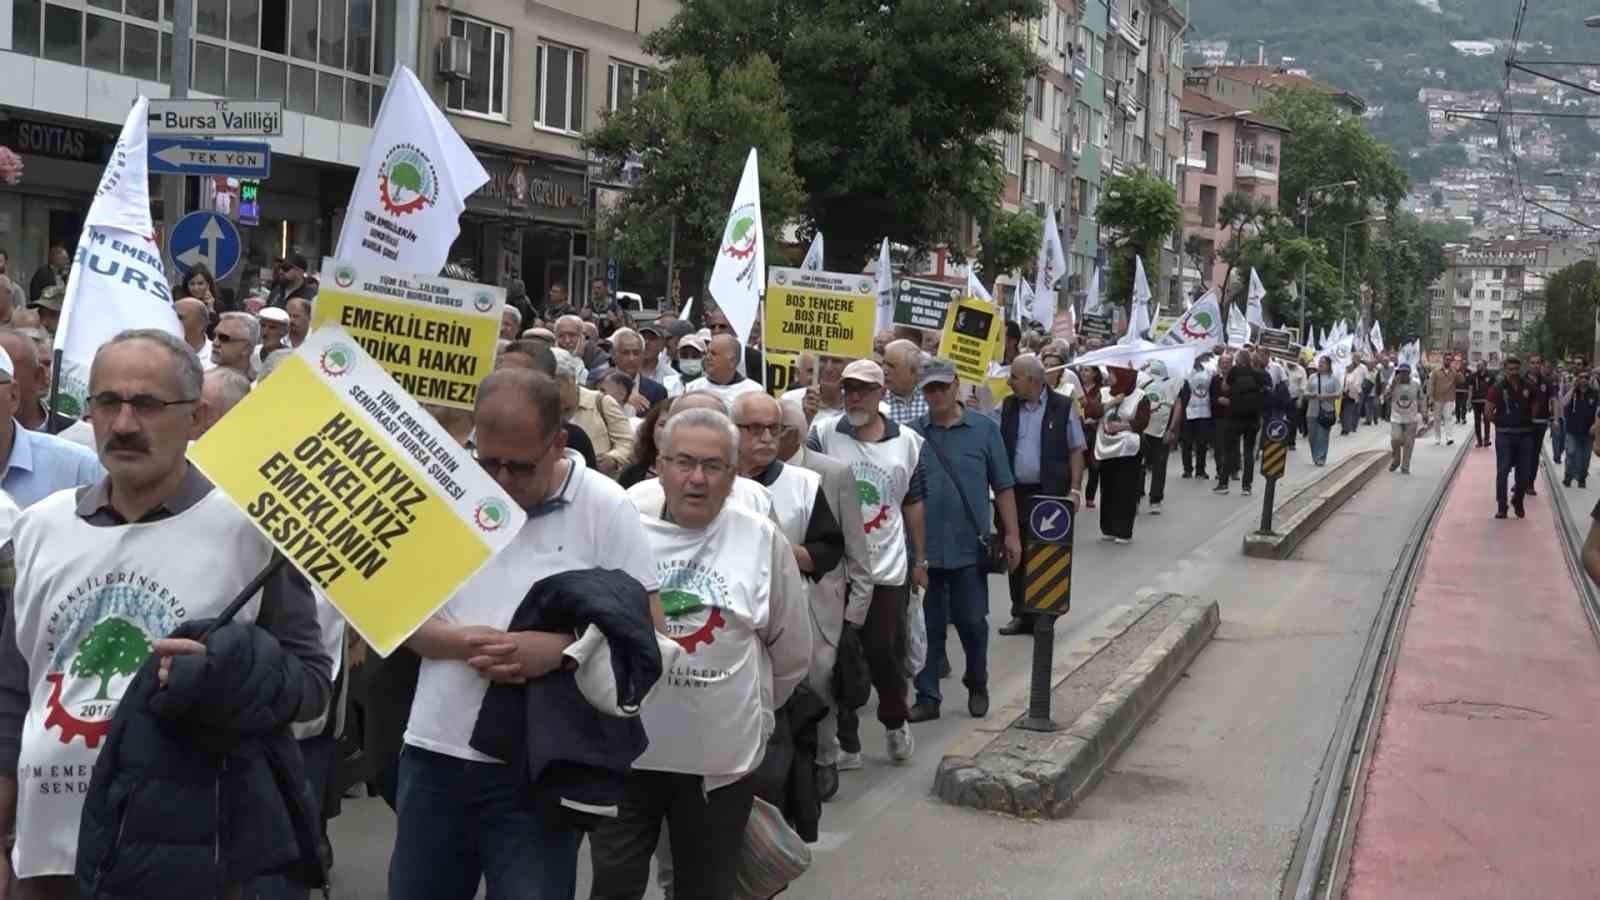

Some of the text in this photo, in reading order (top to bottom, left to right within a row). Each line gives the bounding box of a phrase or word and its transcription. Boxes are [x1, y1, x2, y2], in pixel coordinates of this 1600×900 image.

[165, 111, 278, 133] Bursa Valiliği
[188, 151, 217, 164] TEK
[341, 306, 472, 347] EMEKLİLERİN
[417, 346, 478, 376] HAKKI
[349, 385, 399, 436] SENDİKASI
[396, 432, 431, 467] BURSA
[376, 390, 460, 473] TÜM EMEKLİLERİN
[294, 431, 409, 549] ÖFKELİYİZ
[321, 411, 428, 523] HAKLIYIZ,
[247, 491, 347, 589] SESİYİZ!
[258, 451, 388, 580] EMEKLİNİN
[664, 623, 685, 634] 017
[80, 703, 111, 717] 2017
